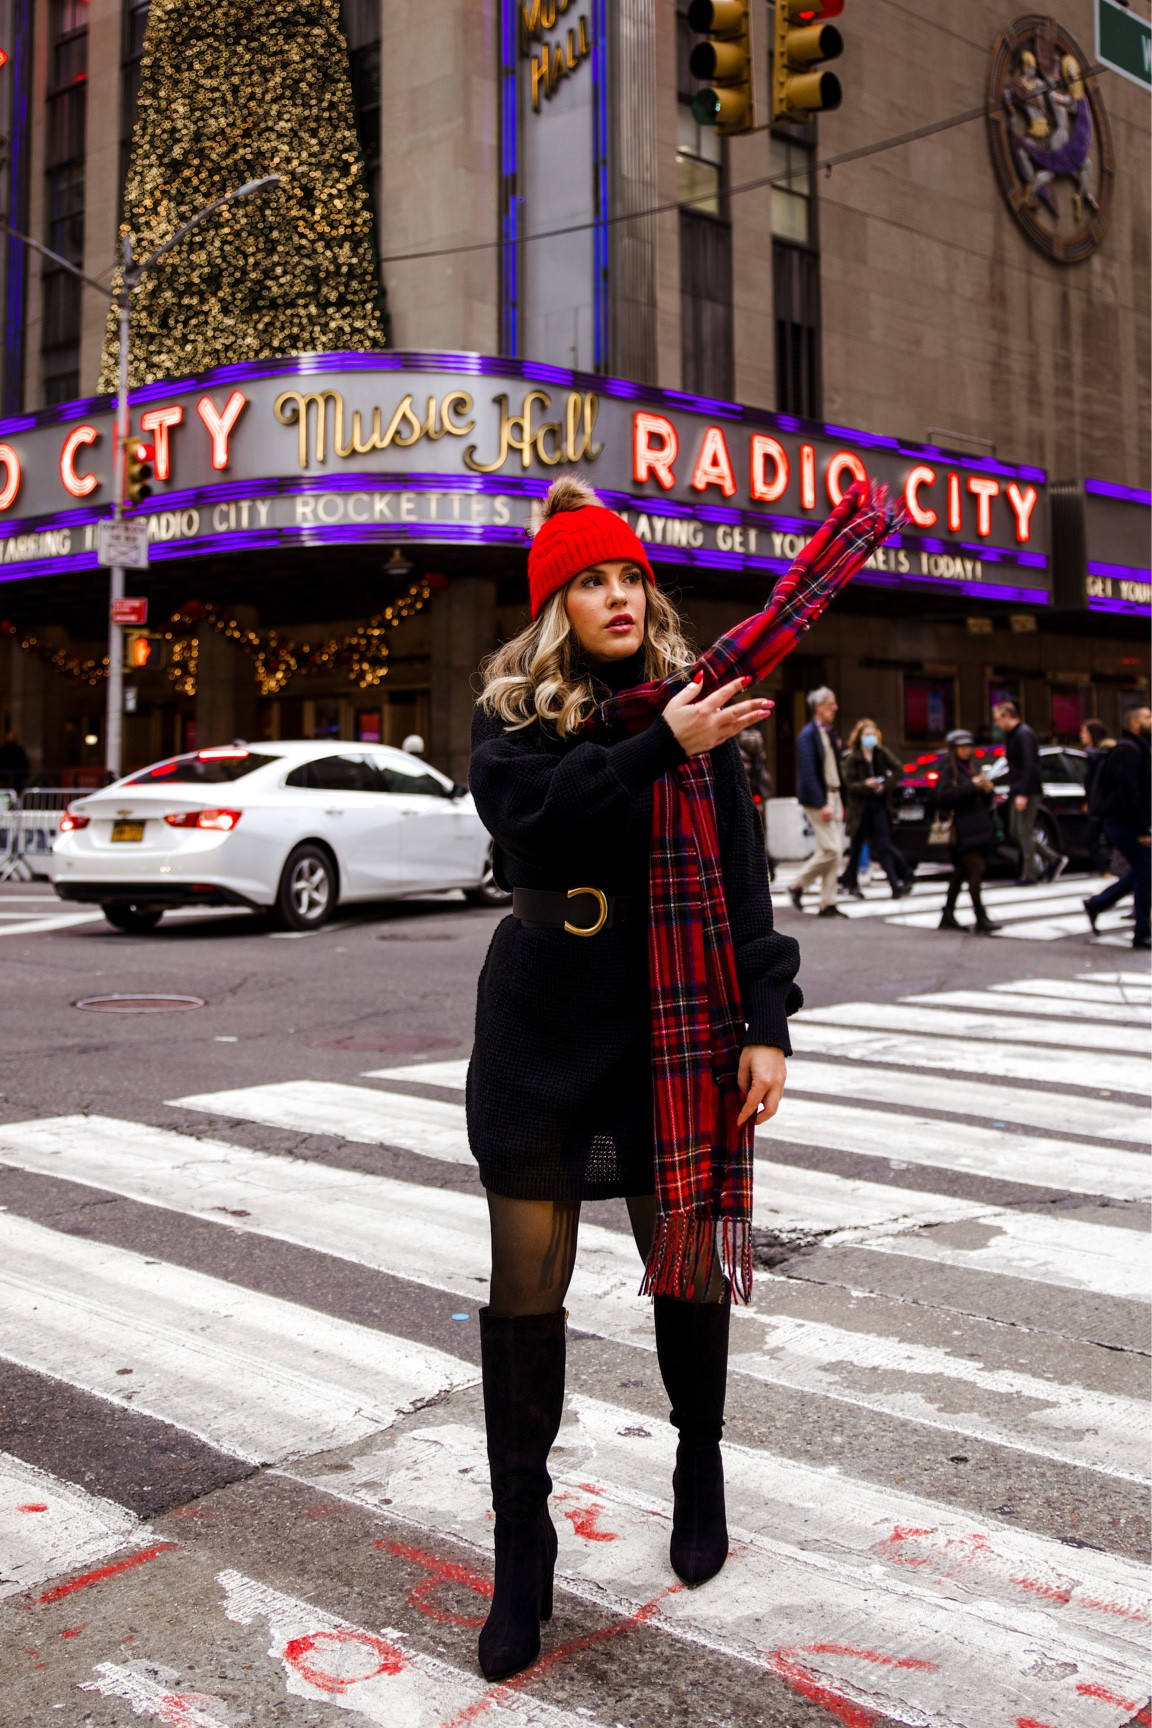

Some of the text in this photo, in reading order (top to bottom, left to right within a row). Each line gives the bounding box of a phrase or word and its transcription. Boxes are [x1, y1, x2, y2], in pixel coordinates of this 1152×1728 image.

[530, 16, 590, 110] HALL
[274, 390, 603, 472] Music Hall
[633, 411, 1037, 542] RADIO CITY
[212, 499, 271, 532] CITY
[295, 492, 510, 525] ROCKETTES
[716, 524, 757, 553] GET
[920, 552, 982, 581] TODAY!
[1086, 575, 1112, 598] GET
